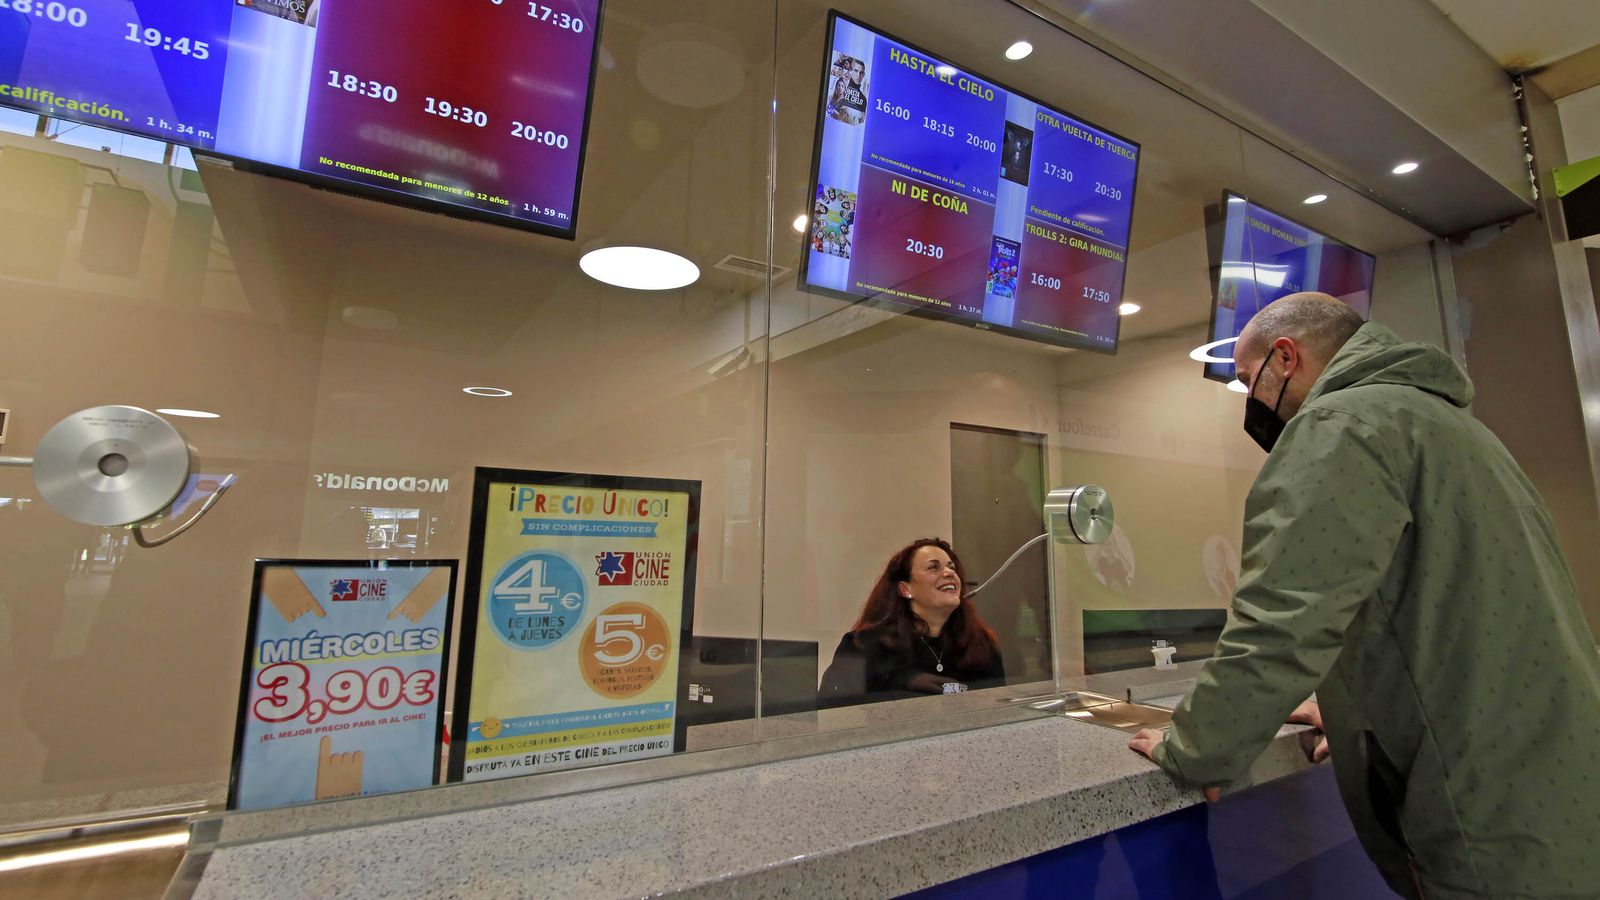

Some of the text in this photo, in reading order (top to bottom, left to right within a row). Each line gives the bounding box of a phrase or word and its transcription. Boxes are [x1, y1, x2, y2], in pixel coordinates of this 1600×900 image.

[527, 1, 584, 33] 17:30
[124, 22, 209, 60] 19:45
[889, 48, 995, 102] HASTA EL CIELO
[0, 83, 130, 122] calificación.
[327, 69, 569, 150] 18:30 19:30 20:00
[147, 116, 214, 140] 1 h. 34 m.
[875, 98, 997, 153] 16:00 18:15 20:00
[1037, 112, 1136, 161] OTRA VUELTA DE TUERCA
[319, 156, 509, 206] No recomendada para menores de 12 años
[879, 155, 911, 170] recomendada
[911, 166, 922, 175] para
[922, 170, 942, 182] menores
[1043, 162, 1121, 201] 17:30 20:30
[523, 203, 569, 220] 1 h. 59 m.
[891, 179, 968, 215] NI DE COÑA
[1030, 205, 1104, 236] Pendiente de calificación.
[1272, 228, 1294, 243] WOMAN
[906, 238, 944, 260] 20:30
[1025, 223, 1124, 262] TROLLS 2: GIRA MUNDIAL
[864, 284, 896, 295] recomendada
[896, 291, 907, 299] para
[908, 294, 927, 302] menores
[1031, 272, 1110, 303] 16:00 17:50
[509, 486, 669, 518] ¡PRECIO ÚNICO!
[527, 522, 652, 533] SIN COMPLICACIONES
[634, 559, 670, 579] CINE
[635, 551, 671, 559] UNIÓN
[359, 583, 387, 597] CINE
[508, 616, 566, 628] DE LUNES
[508, 628, 562, 641] A JUEVES
[260, 628, 440, 665] MIÉRCOLES
[700, 649, 717, 663] LG
[254, 661, 435, 724] 3,90€
[260, 733, 275, 743] ¡EL
[278, 728, 312, 738] MEJOR
[315, 724, 349, 734] PRECIO
[352, 720, 376, 729] PARA
[390, 716, 401, 724] AL
[402, 712, 426, 721] CINE!
[466, 760, 507, 773] DISFRUTA
[525, 754, 541, 766] EN
[544, 750, 571, 764] ESTE
[574, 747, 600, 759] CINE
[602, 747, 617, 756] DEL
[619, 742, 645, 754] PRECIO
